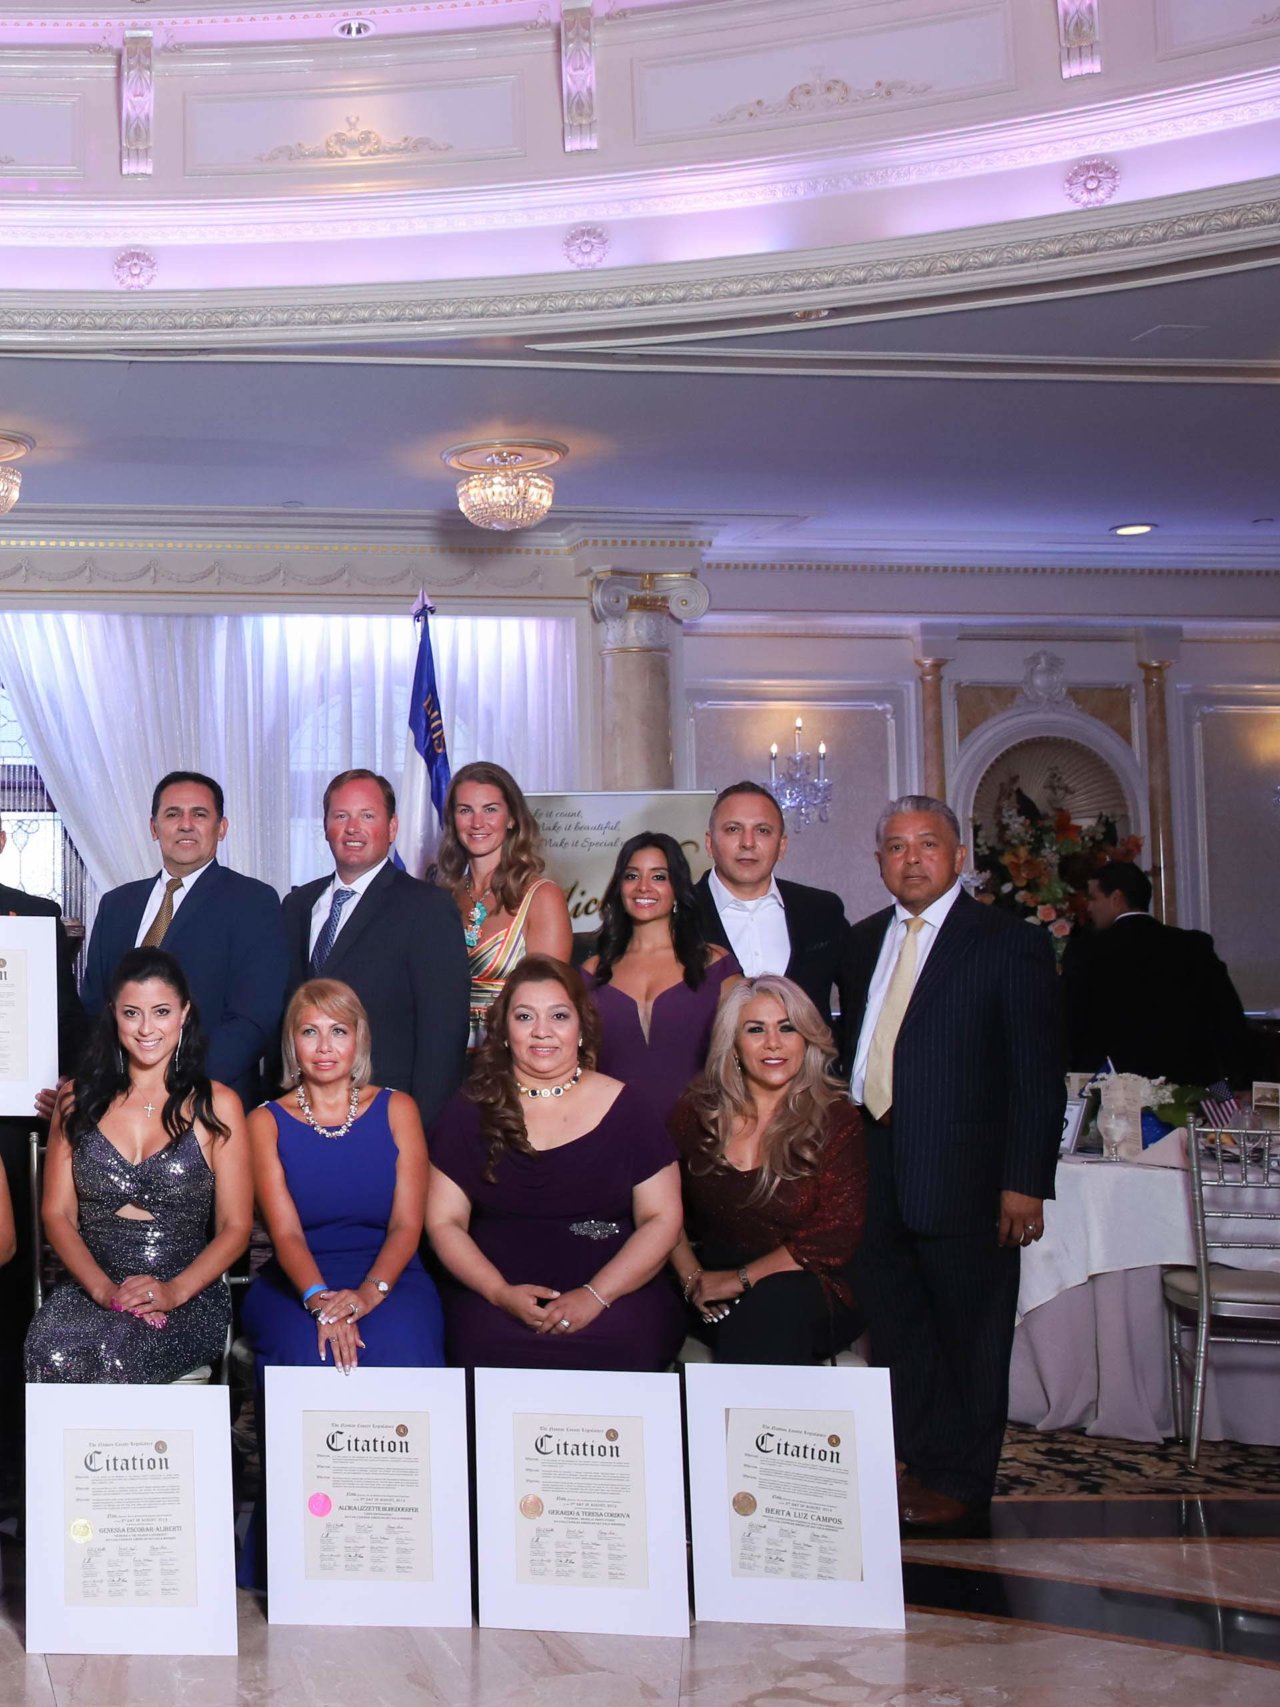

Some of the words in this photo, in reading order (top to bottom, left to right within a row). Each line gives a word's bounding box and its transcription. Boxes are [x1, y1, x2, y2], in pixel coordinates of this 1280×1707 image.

[580, 836, 620, 852] Special
[326, 1430, 410, 1453] Citation
[534, 1434, 621, 1458] Citation
[755, 1432, 841, 1464] Citation
[84, 1450, 170, 1472] Citation
[765, 1507, 791, 1518] BERTA
[793, 1511, 808, 1520] LUZ
[810, 1514, 843, 1525] CAMPOS
